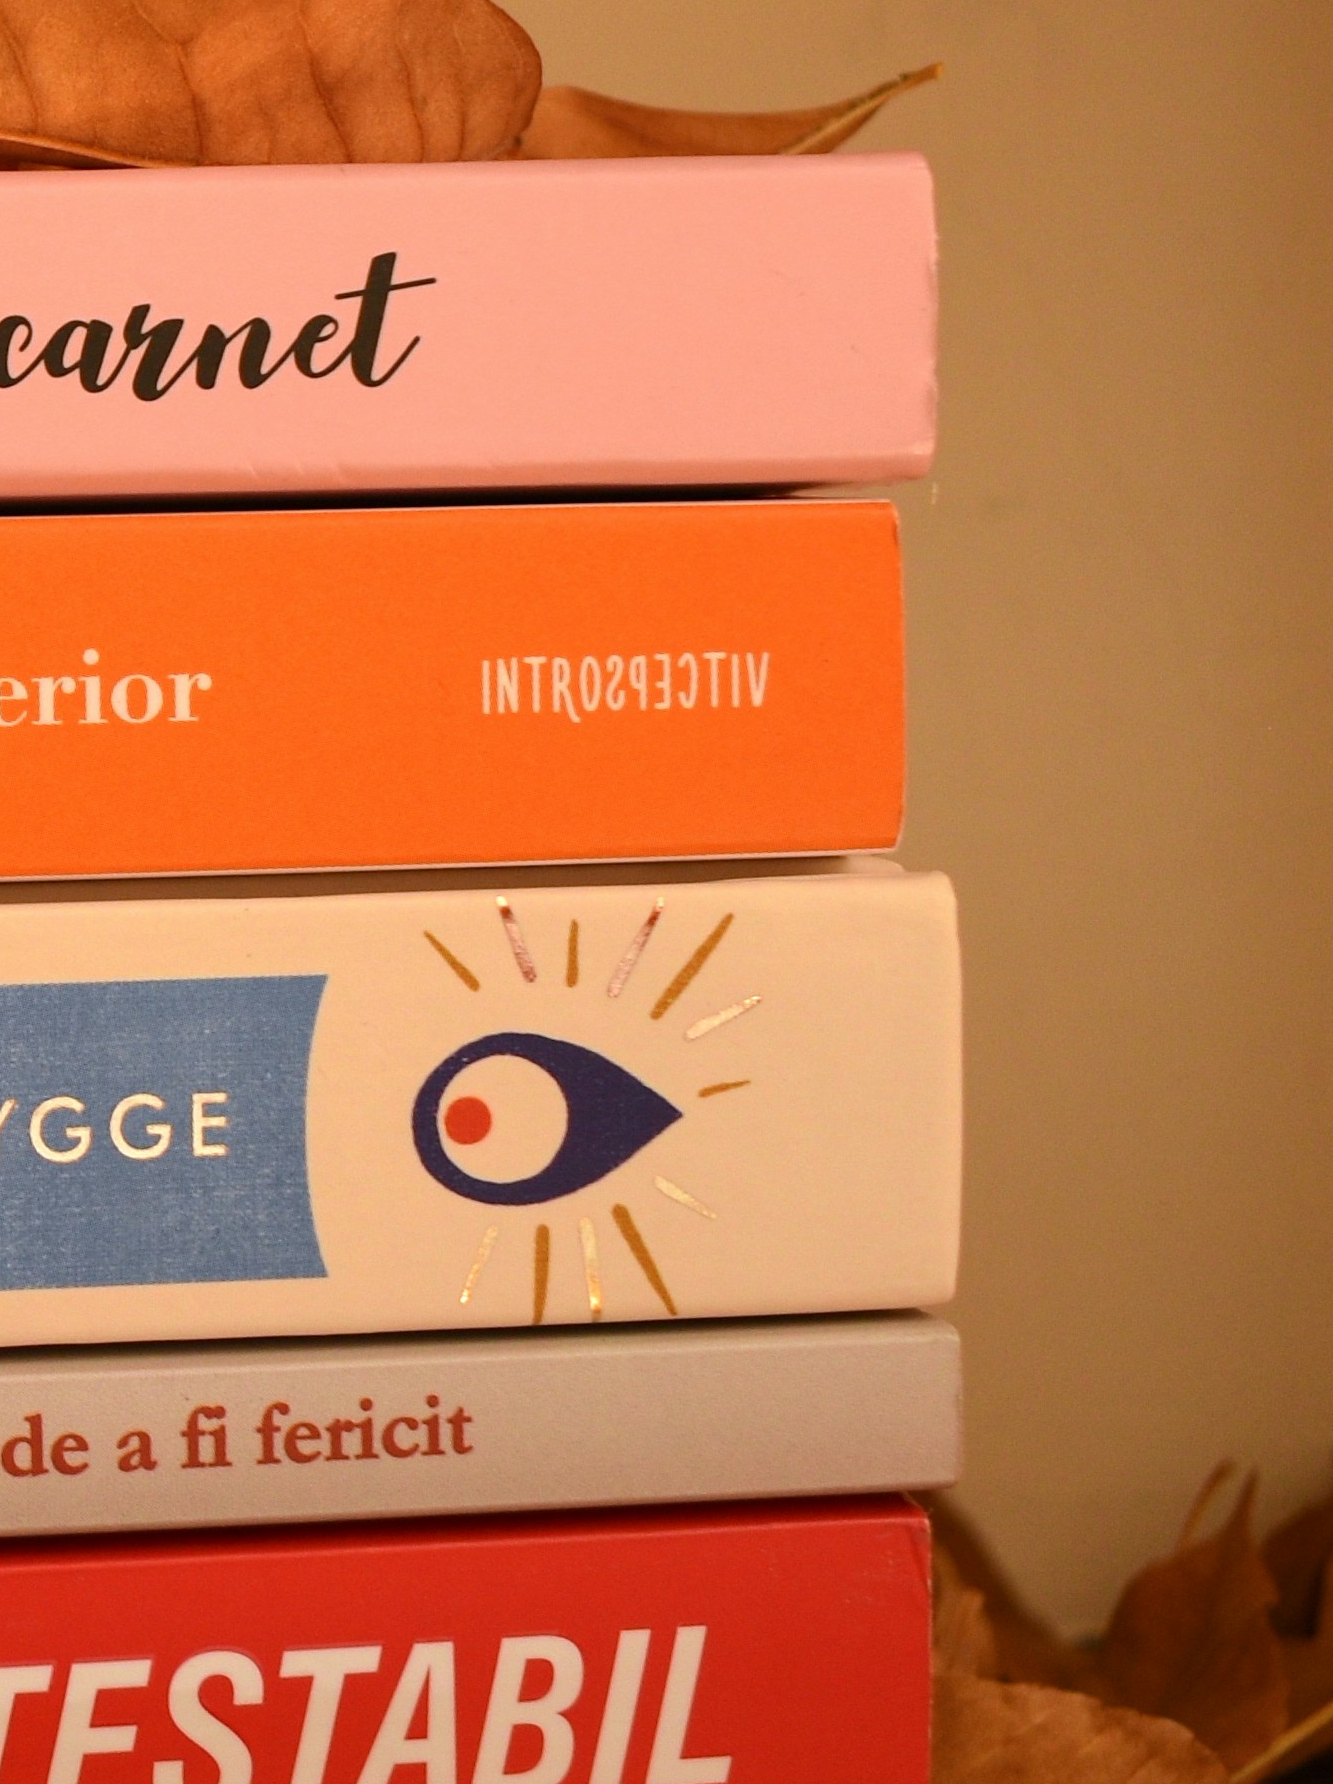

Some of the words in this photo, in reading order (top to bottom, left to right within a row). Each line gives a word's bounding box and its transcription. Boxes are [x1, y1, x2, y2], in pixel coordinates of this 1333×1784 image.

[0, 1412, 90, 1478] de
[116, 1430, 159, 1474] a
[180, 1405, 234, 1470] fi
[255, 1394, 474, 1466] fericit
